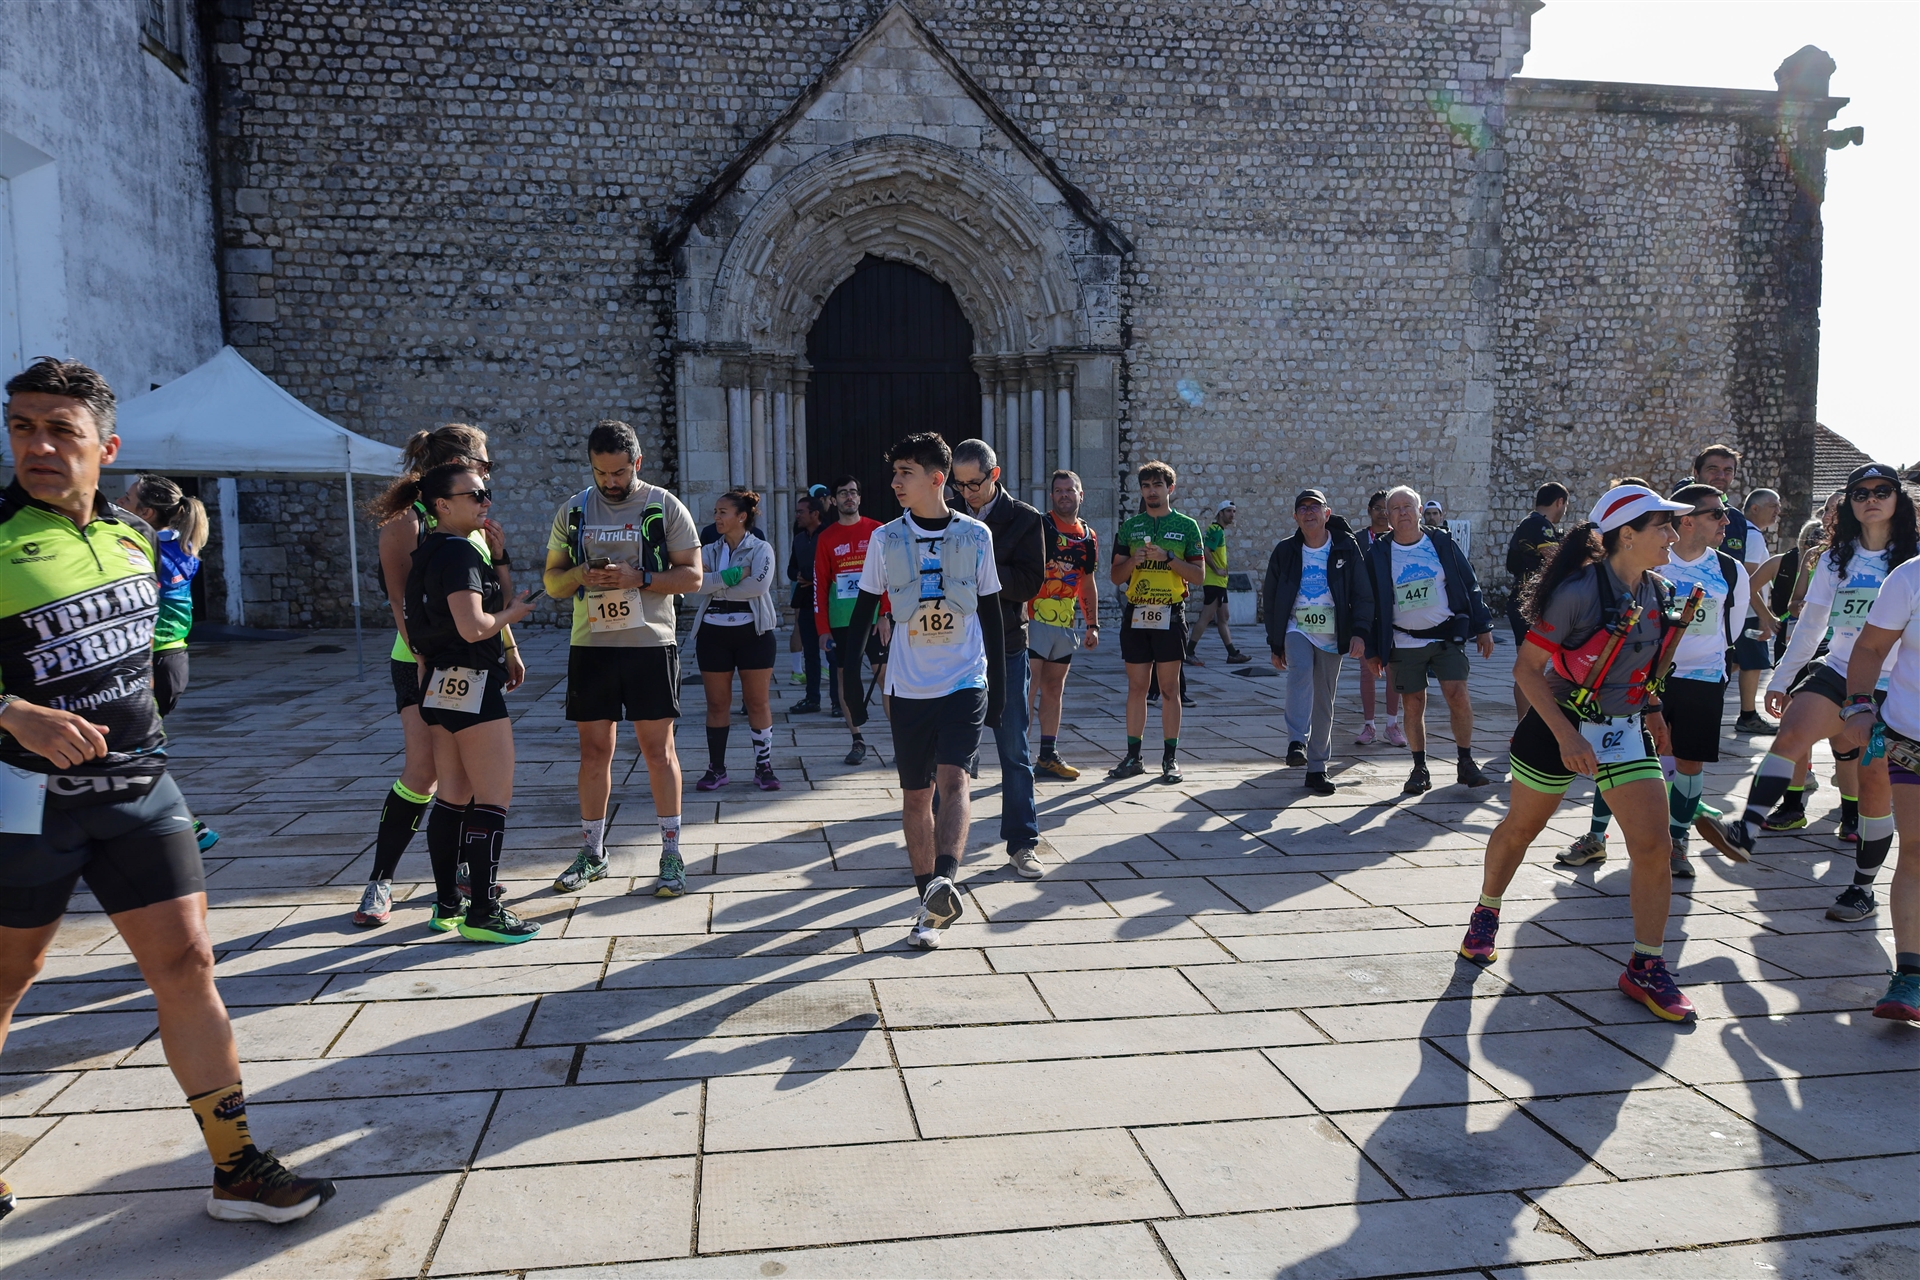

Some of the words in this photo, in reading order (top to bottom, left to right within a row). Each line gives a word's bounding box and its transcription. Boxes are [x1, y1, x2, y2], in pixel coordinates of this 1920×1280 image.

[598, 531, 639, 542] ATHLET
[1405, 586, 1429, 601] 447
[22, 579, 158, 641] TRILHO
[597, 601, 631, 619] 185
[1140, 610, 1162, 621] 186
[1304, 613, 1326, 625] 409
[919, 612, 954, 631] 182
[438, 677, 470, 697] 159
[1602, 730, 1624, 749] 62
